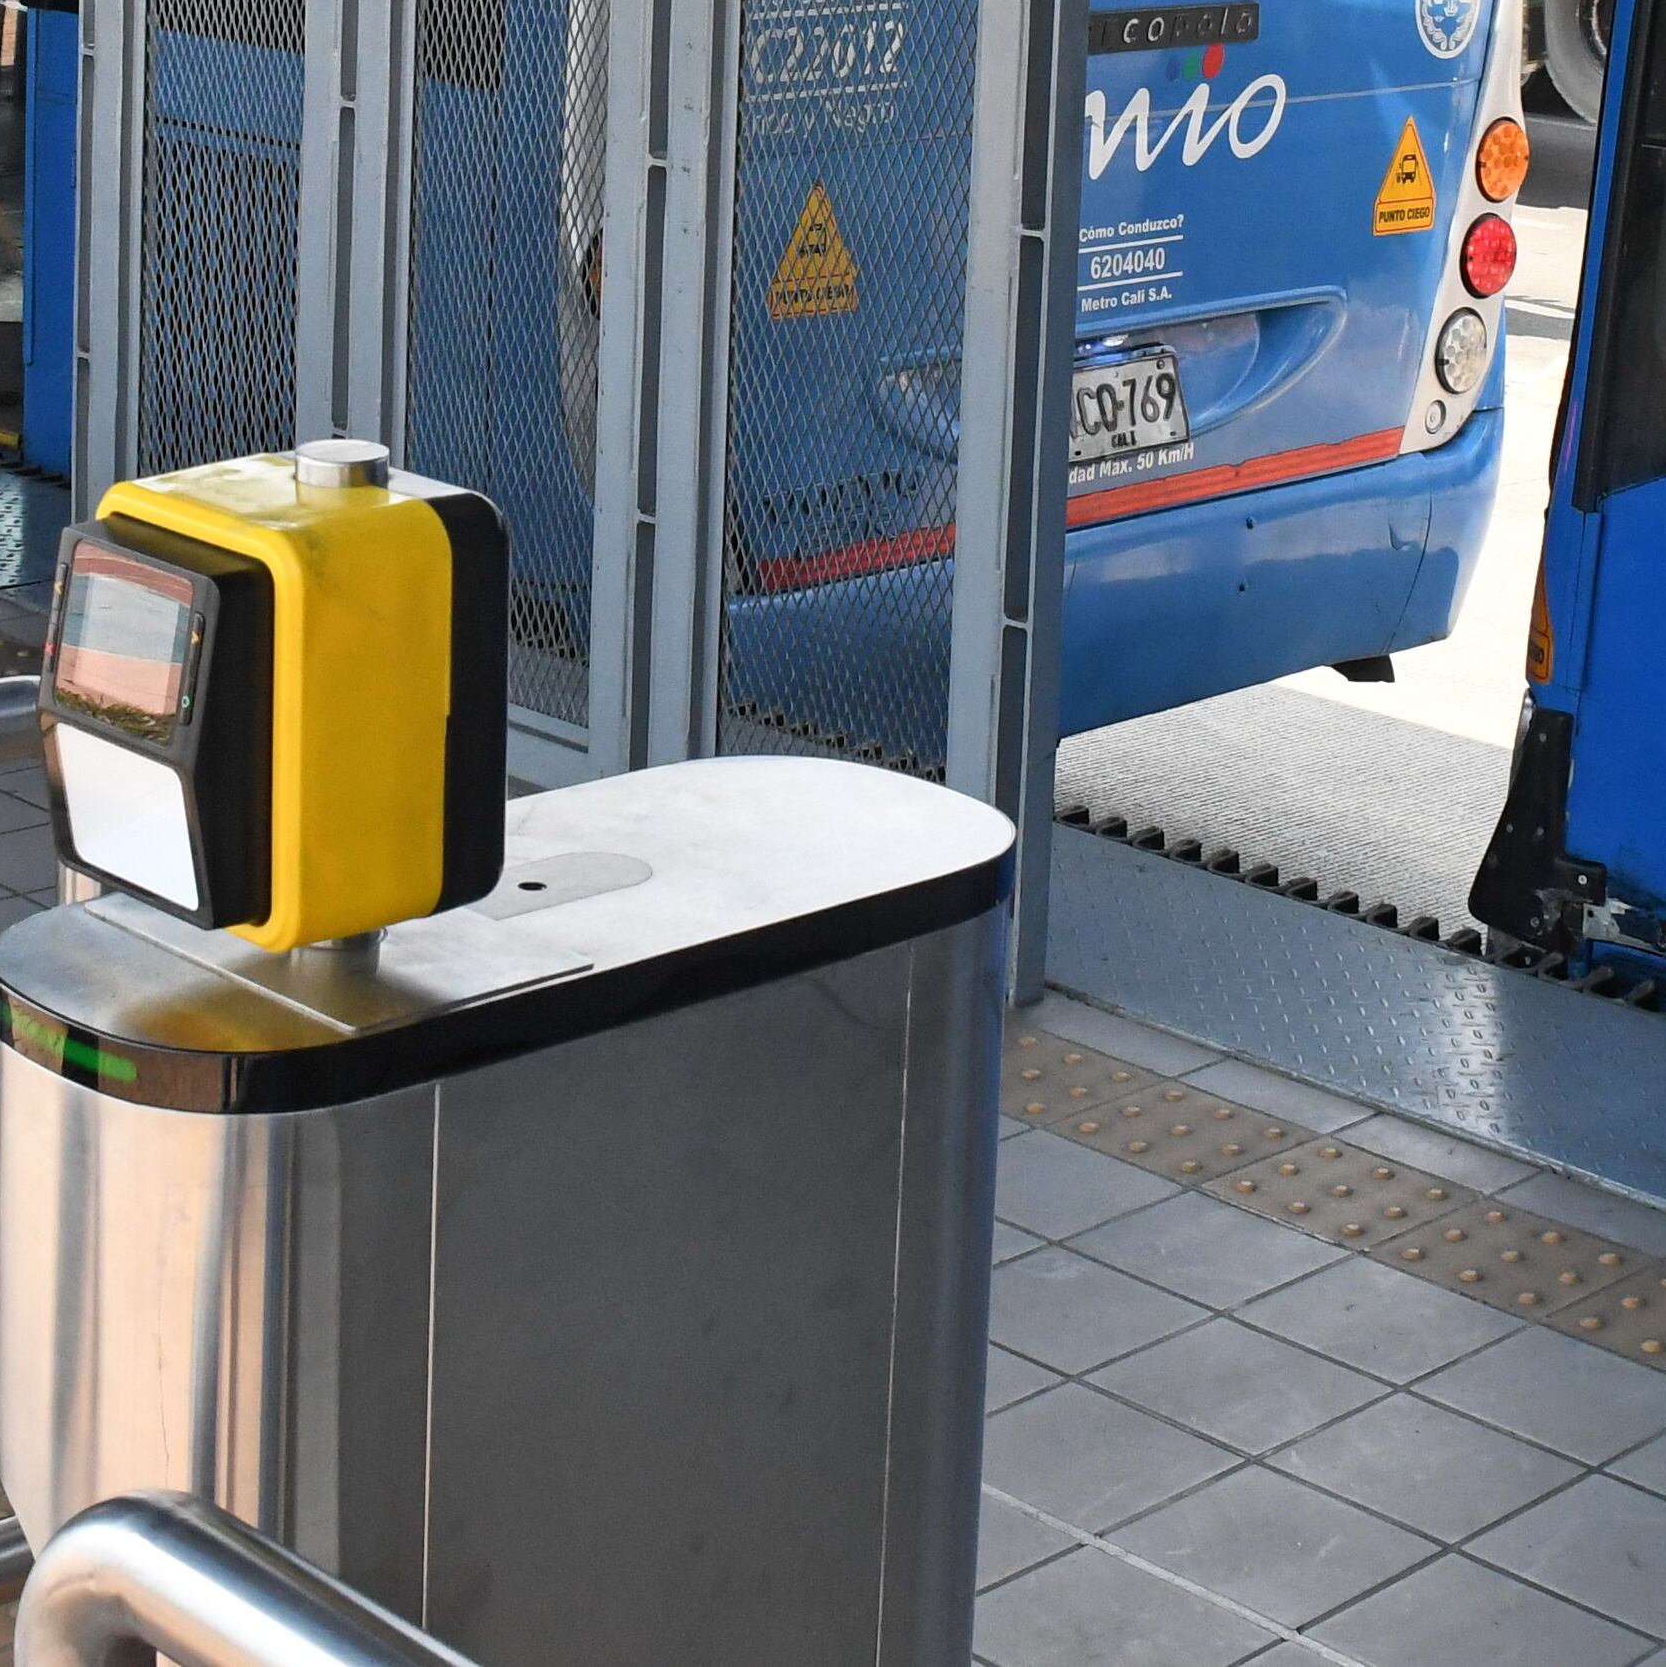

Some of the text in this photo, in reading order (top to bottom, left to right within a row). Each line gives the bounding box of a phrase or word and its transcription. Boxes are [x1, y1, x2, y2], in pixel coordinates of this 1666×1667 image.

[749, 20, 904, 84] C22012
[1079, 214, 1185, 242] Cómo Conduzco?
[1378, 206, 1430, 223] PUNTO CIEGO
[1090, 247, 1165, 279] 6204040
[1081, 286, 1172, 313] Metro Cali S.A.
[1069, 442, 1195, 484] dad Max. 50 Km/H
